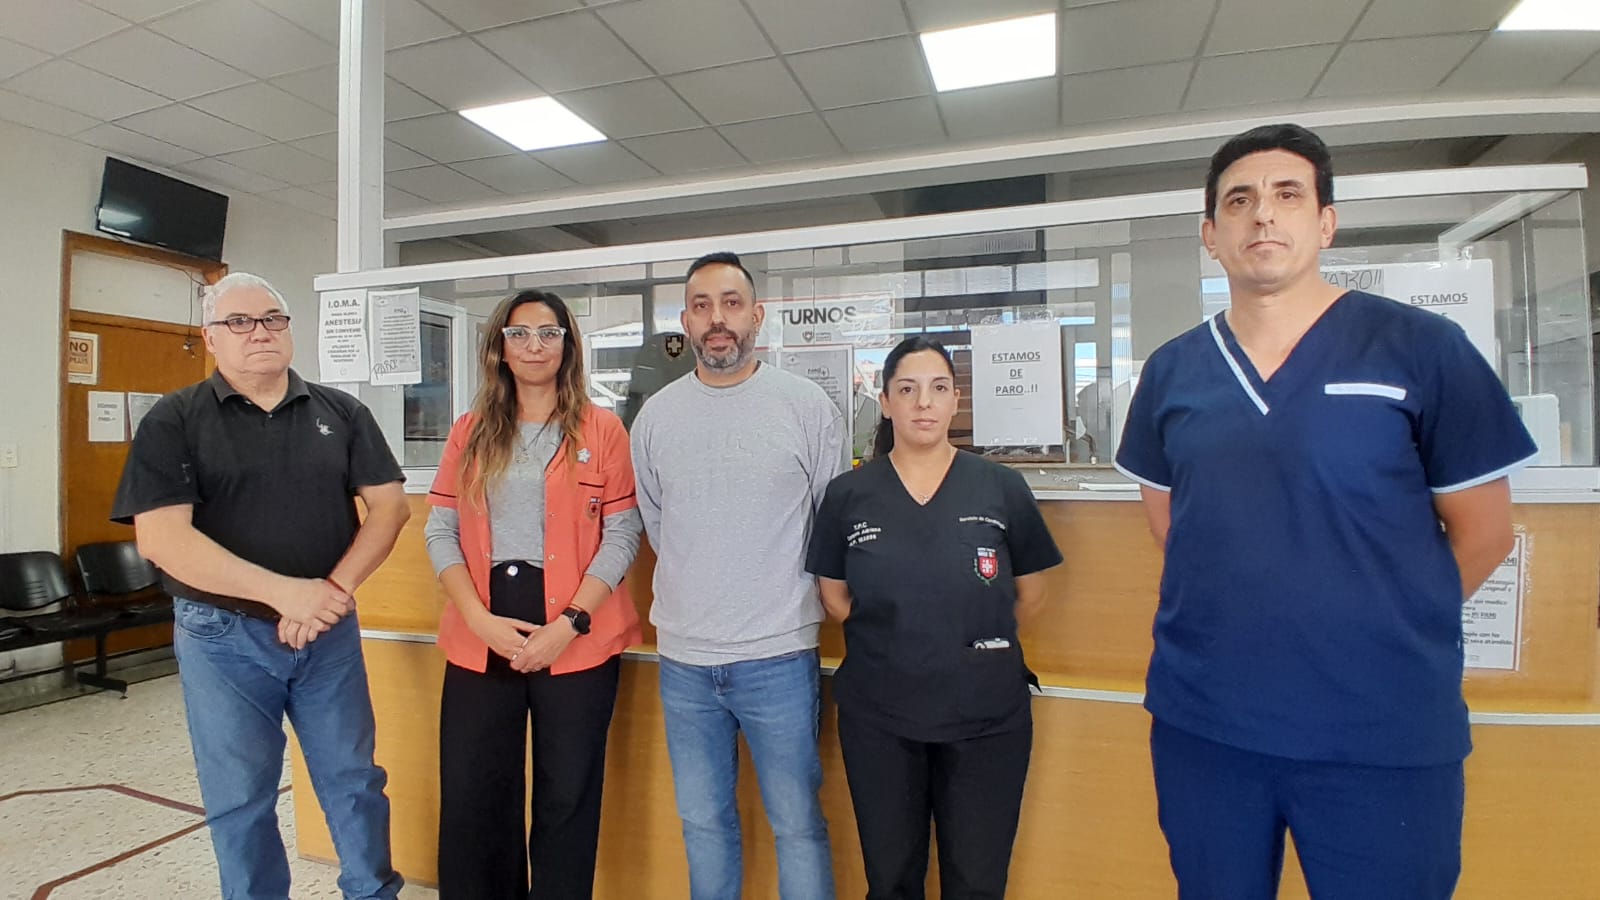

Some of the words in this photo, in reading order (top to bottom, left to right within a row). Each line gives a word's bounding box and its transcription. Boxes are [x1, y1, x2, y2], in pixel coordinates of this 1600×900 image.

[1410, 292, 1468, 304] ESTAMOS
[777, 306, 857, 325] TURNOS
[70, 341, 89, 353] NO
[992, 351, 1041, 362] ESTAMOS
[1009, 368, 1024, 378] DE
